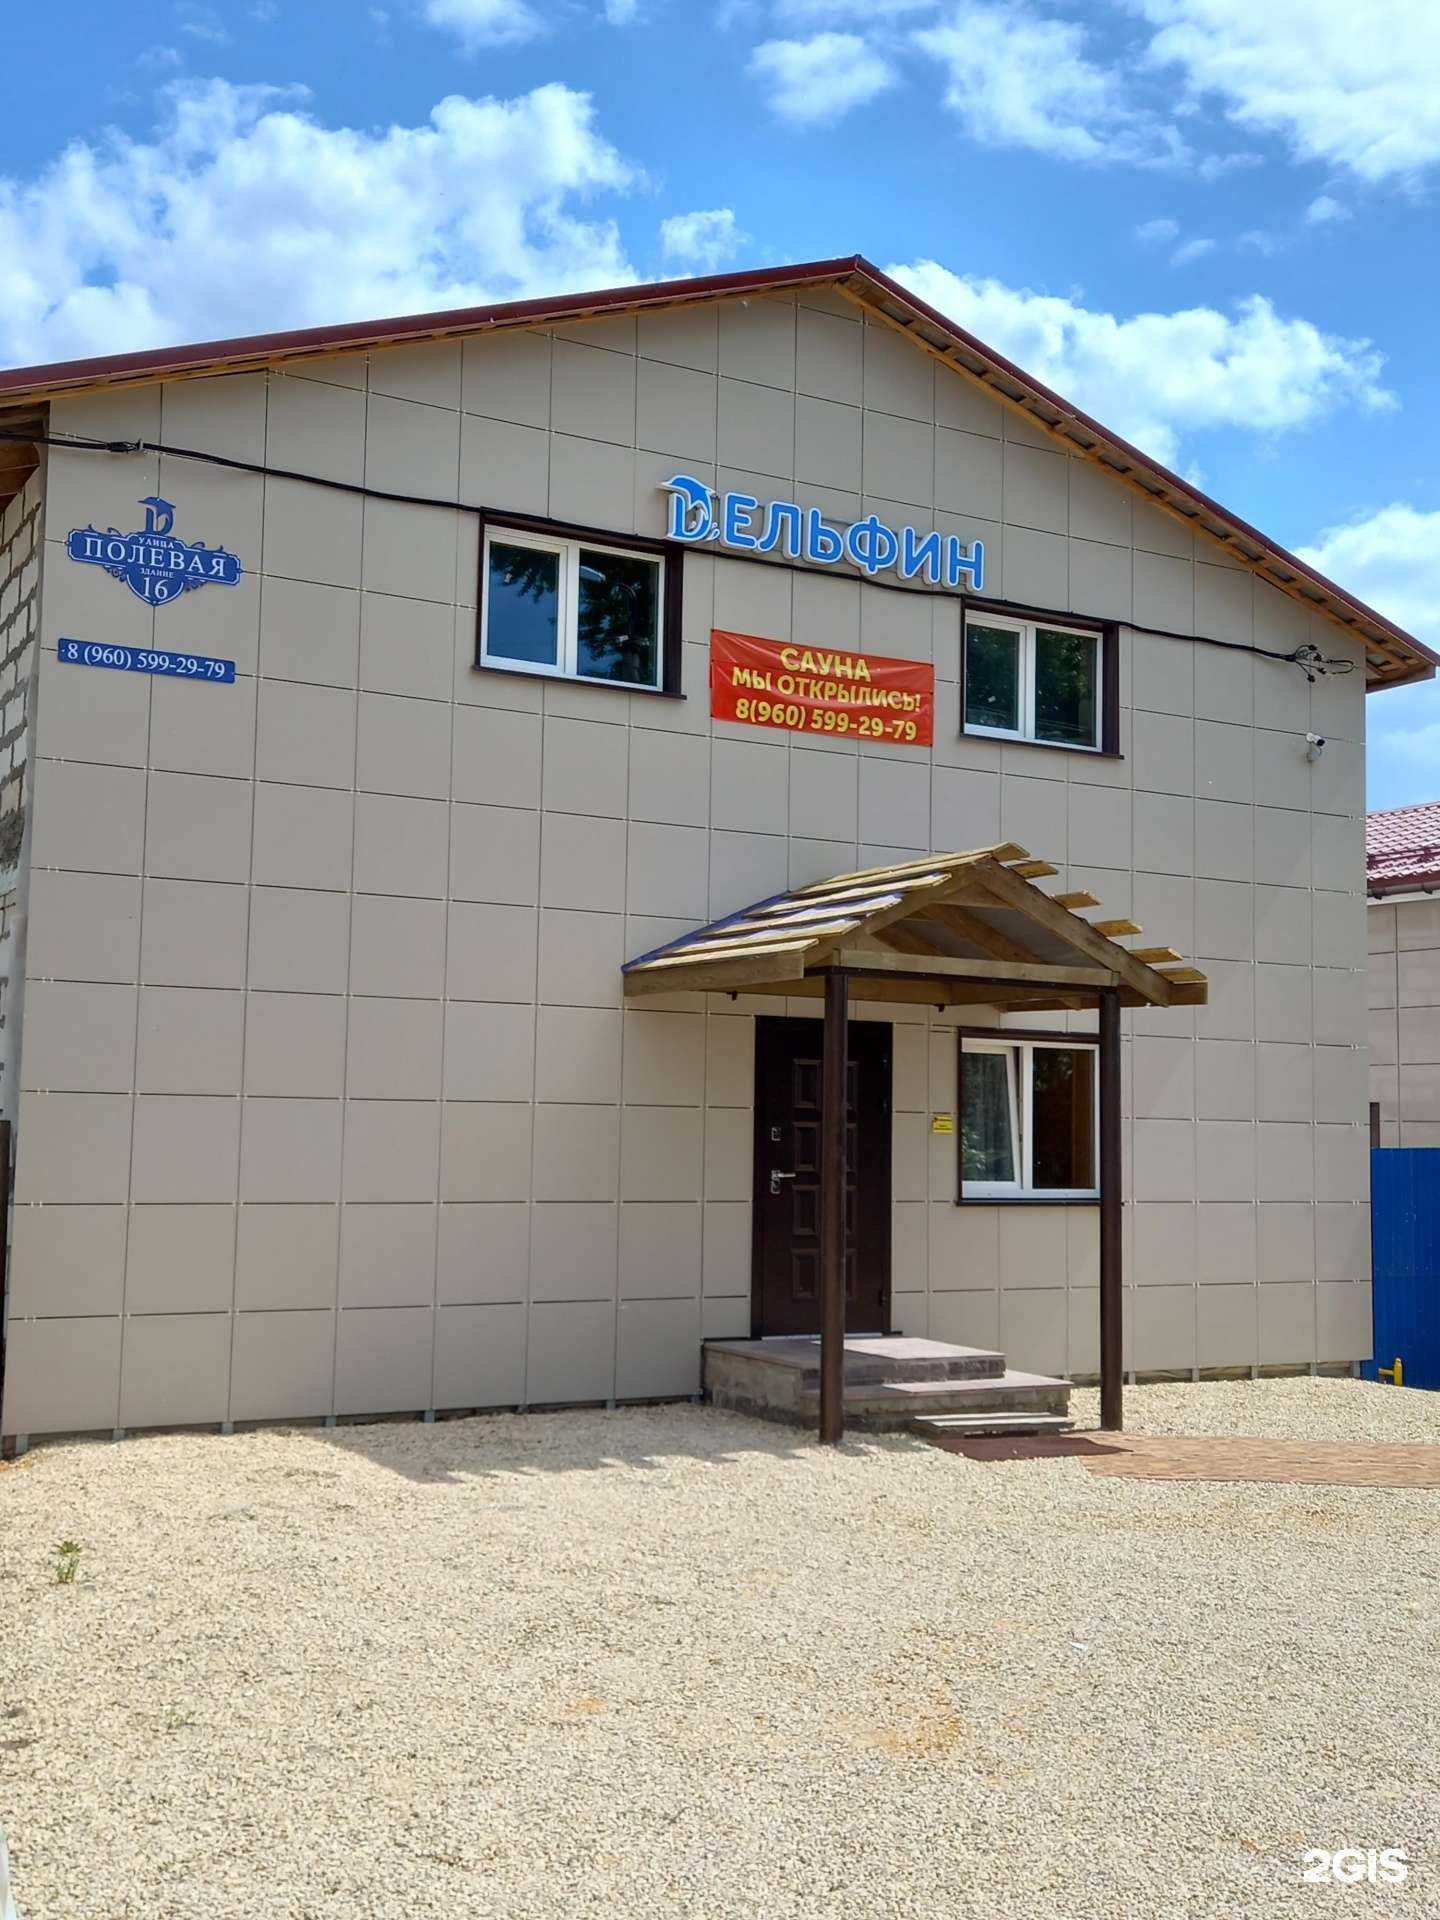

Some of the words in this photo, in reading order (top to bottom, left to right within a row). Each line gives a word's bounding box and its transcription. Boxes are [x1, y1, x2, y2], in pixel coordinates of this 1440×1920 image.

[83, 537, 227, 577] ПОЛЕВАЯ
[138, 536, 174, 549] УЛИЦА
[139, 567, 174, 579] ЗДАНИЕ
[143, 578, 168, 600] 16
[67, 643, 78, 659] 8
[84, 644, 131, 669] (960)
[137, 652, 225, 678] 599-29-79
[779, 647, 872, 682] САУНА
[732, 666, 771, 691] МЫ
[777, 675, 921, 712] ОТКРЫЛИСЬ!
[735, 698, 805, 729] 8(960)
[810, 708, 917, 741] 599-29-79
